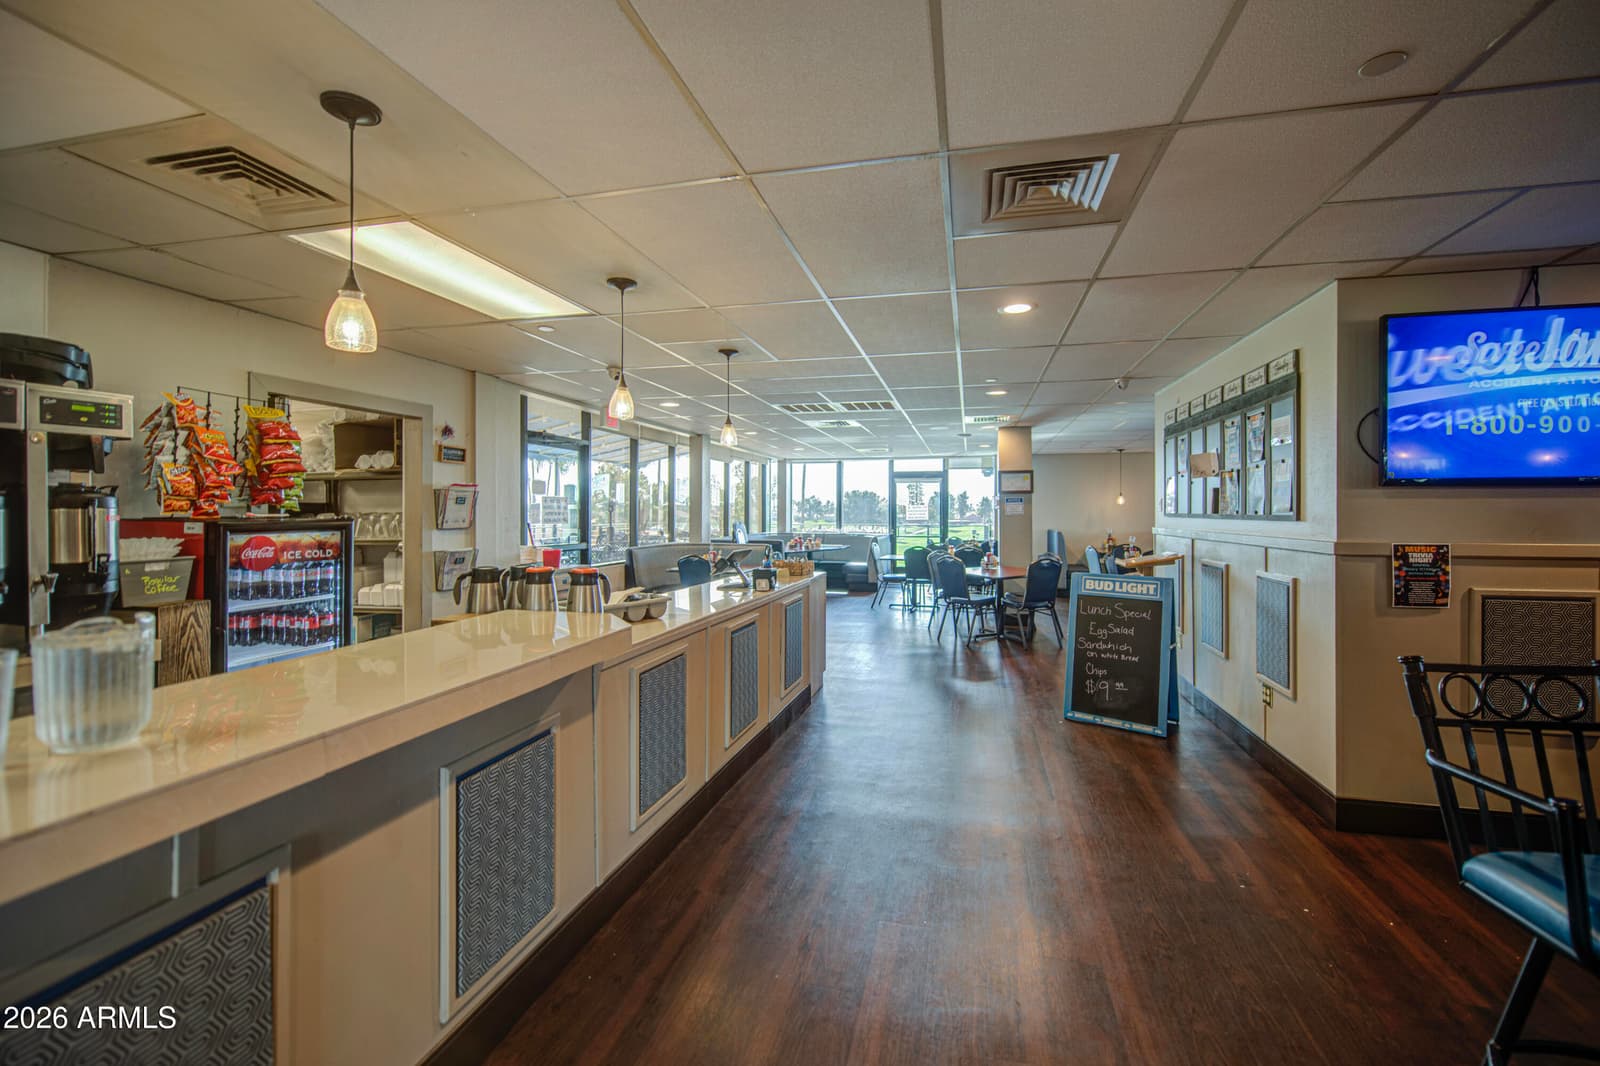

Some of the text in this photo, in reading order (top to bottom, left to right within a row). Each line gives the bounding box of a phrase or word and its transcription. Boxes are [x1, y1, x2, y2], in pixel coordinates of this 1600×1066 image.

[284, 549, 333, 560] ICE COLD
[1085, 579, 1157, 595] BUD LIGHT
[1080, 599, 1152, 621] Lunch Special
[1089, 621, 1135, 639] Egg Salad
[1086, 651, 1098, 659] on
[1085, 662, 1108, 678] Chips
